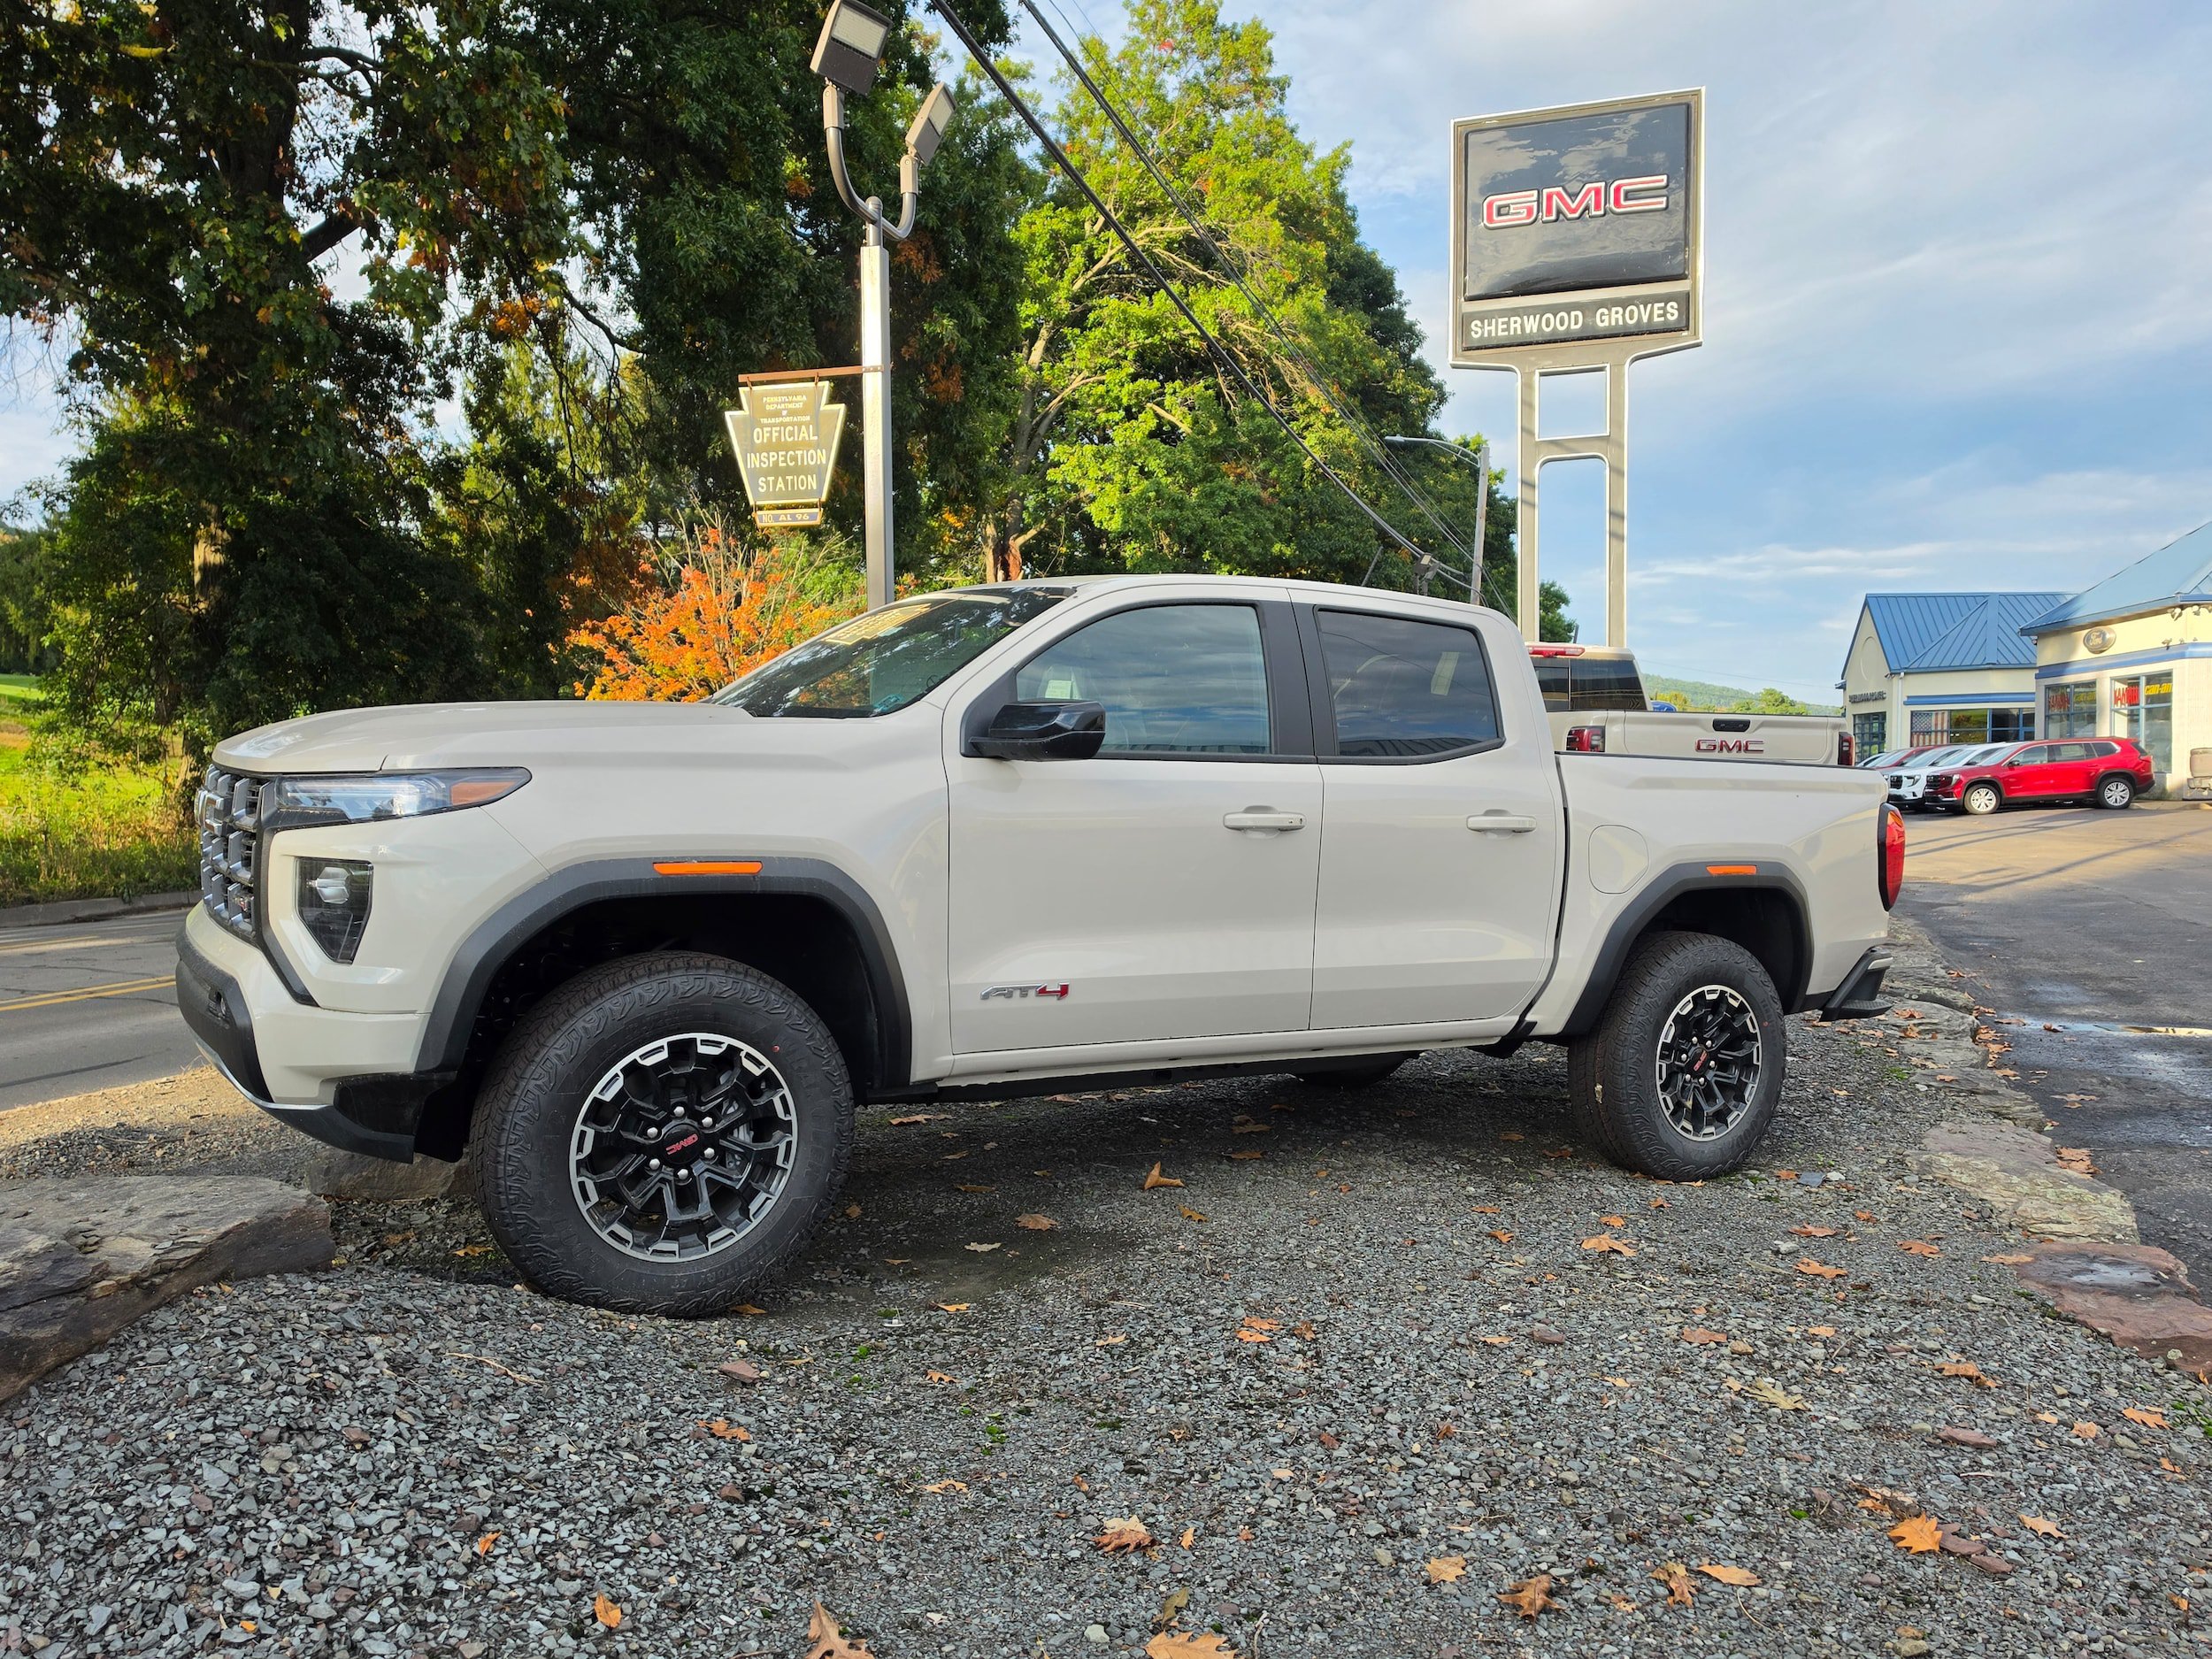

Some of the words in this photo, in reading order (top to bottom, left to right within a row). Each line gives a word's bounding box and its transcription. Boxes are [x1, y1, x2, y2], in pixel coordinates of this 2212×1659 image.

[1483, 174, 1669, 231] GMC
[1470, 311, 1584, 340] SHERWOOD
[1595, 301, 1679, 327] GROVES
[762, 395, 807, 403] PENNSYLVANIA
[765, 402, 804, 411] DEPARTMENT
[759, 415, 811, 424] TRANSPORTATION
[753, 424, 818, 444] OFFICIAL
[747, 449, 826, 469] INSPECTION
[757, 473, 818, 493] STATION
[1695, 739, 1764, 755] GMC
[980, 982, 1070, 1001] AT4
[665, 1133, 699, 1156] GMC
